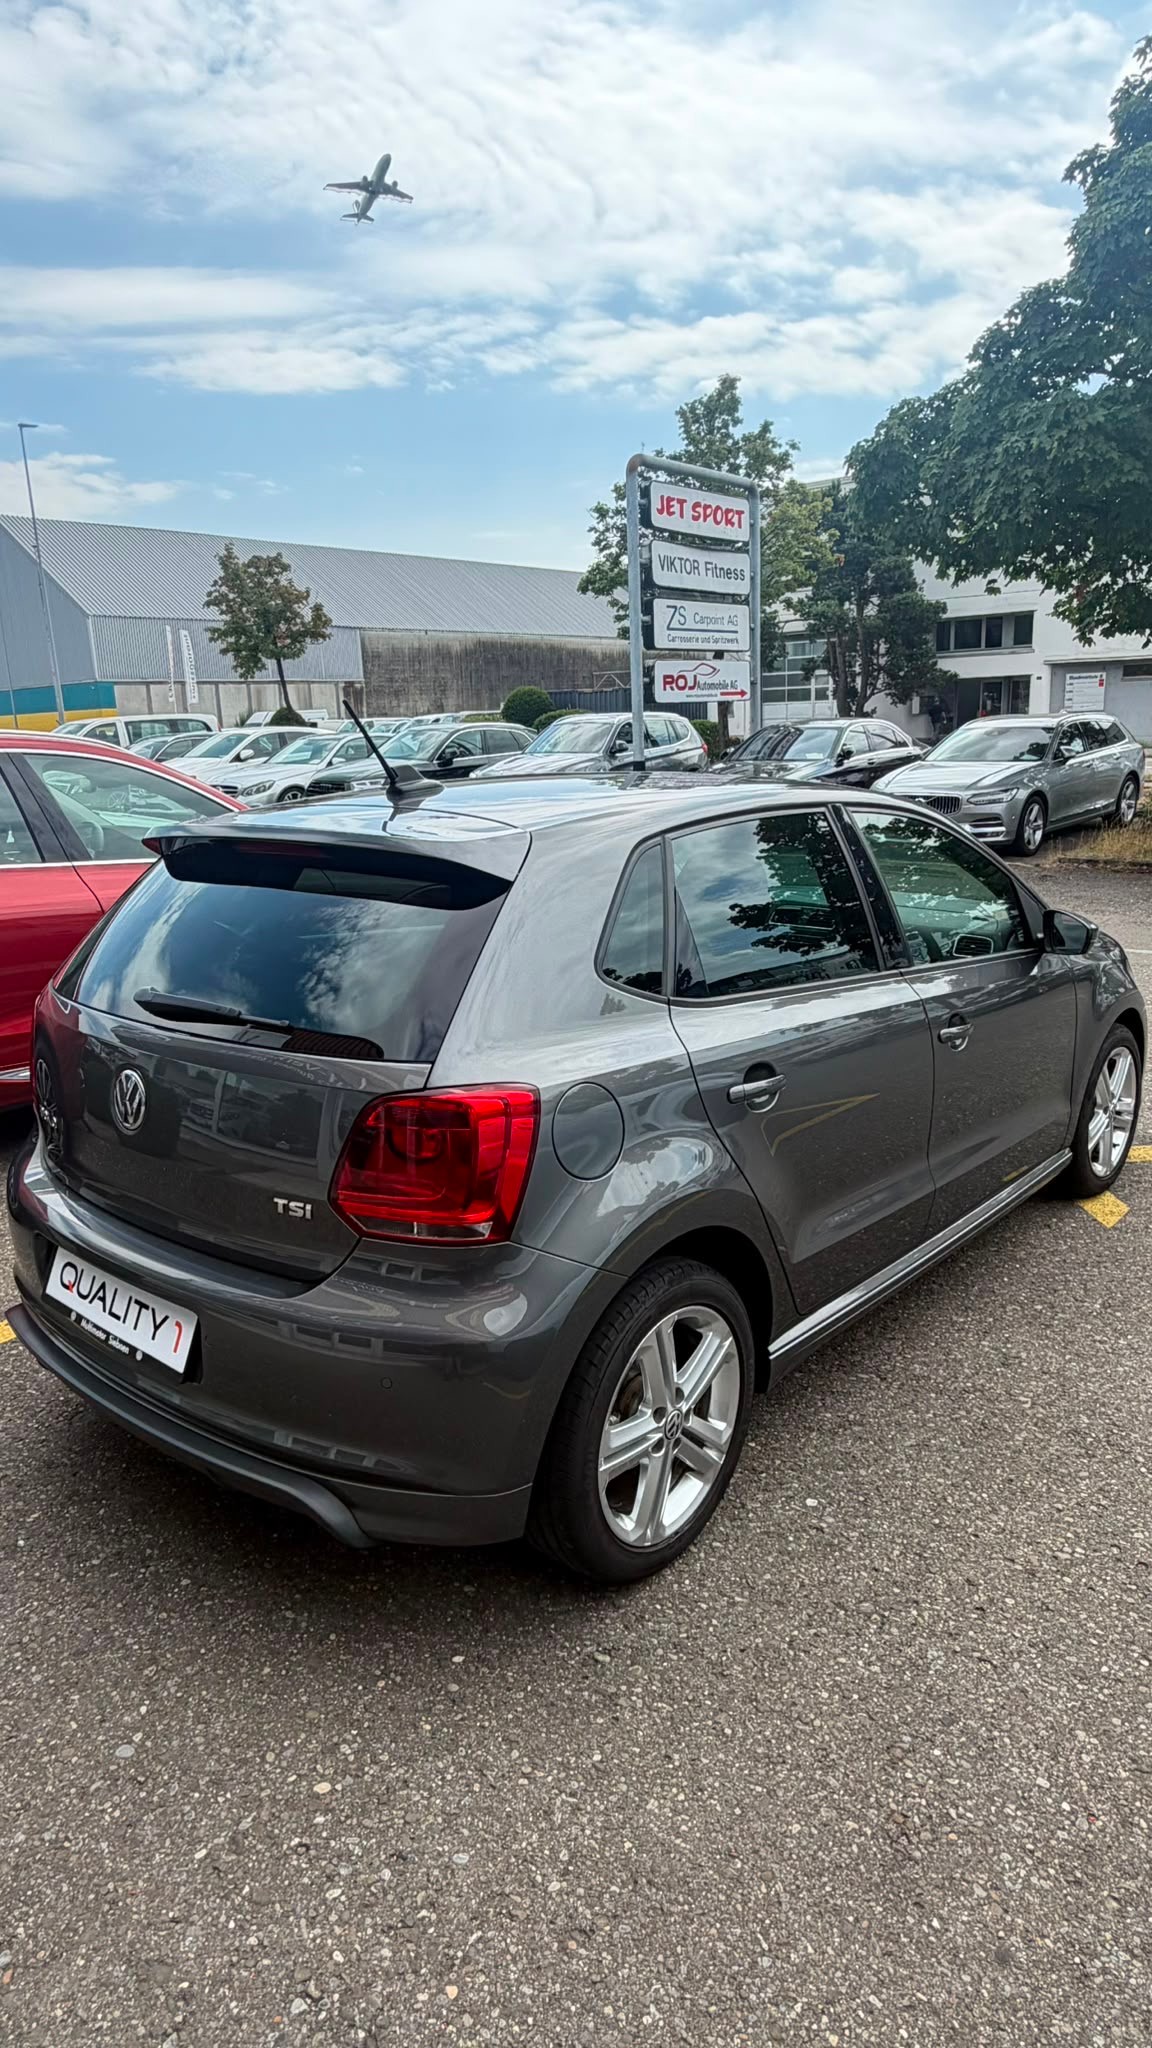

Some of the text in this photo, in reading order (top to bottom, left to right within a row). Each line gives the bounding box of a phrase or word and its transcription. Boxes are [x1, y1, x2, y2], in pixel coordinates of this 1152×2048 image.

[656, 495, 745, 529] JET SPORT
[658, 554, 745, 581] VIKTOR Fitness
[666, 605, 738, 631] ZS Carpoint AG
[701, 636, 711, 645] und
[663, 675, 738, 691] ROJ Automobile AG
[273, 1197, 312, 1220] TSI
